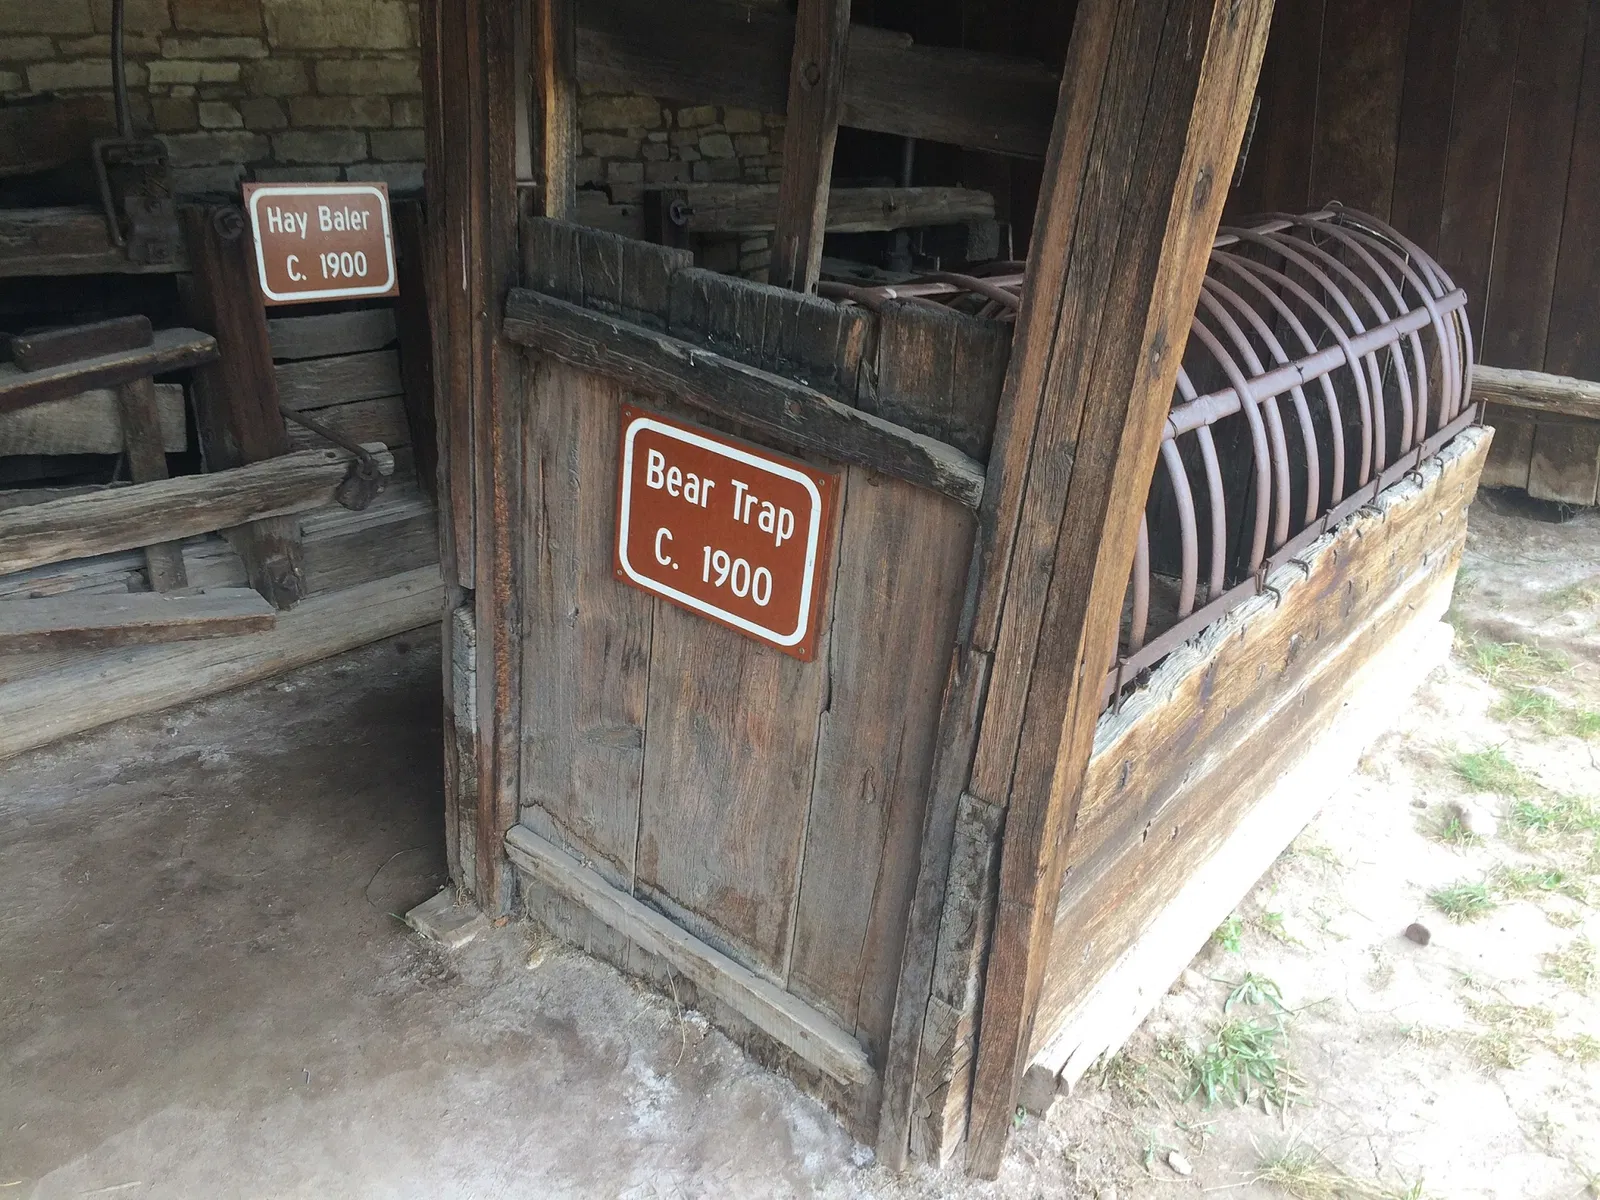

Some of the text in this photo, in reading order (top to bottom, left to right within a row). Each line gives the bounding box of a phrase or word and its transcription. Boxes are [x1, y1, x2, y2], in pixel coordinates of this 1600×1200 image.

[266, 204, 370, 240] Hay Baler
[286, 250, 368, 281] C. 1900
[646, 448, 796, 547] Bear Trap
[654, 527, 774, 608] C. 1900
